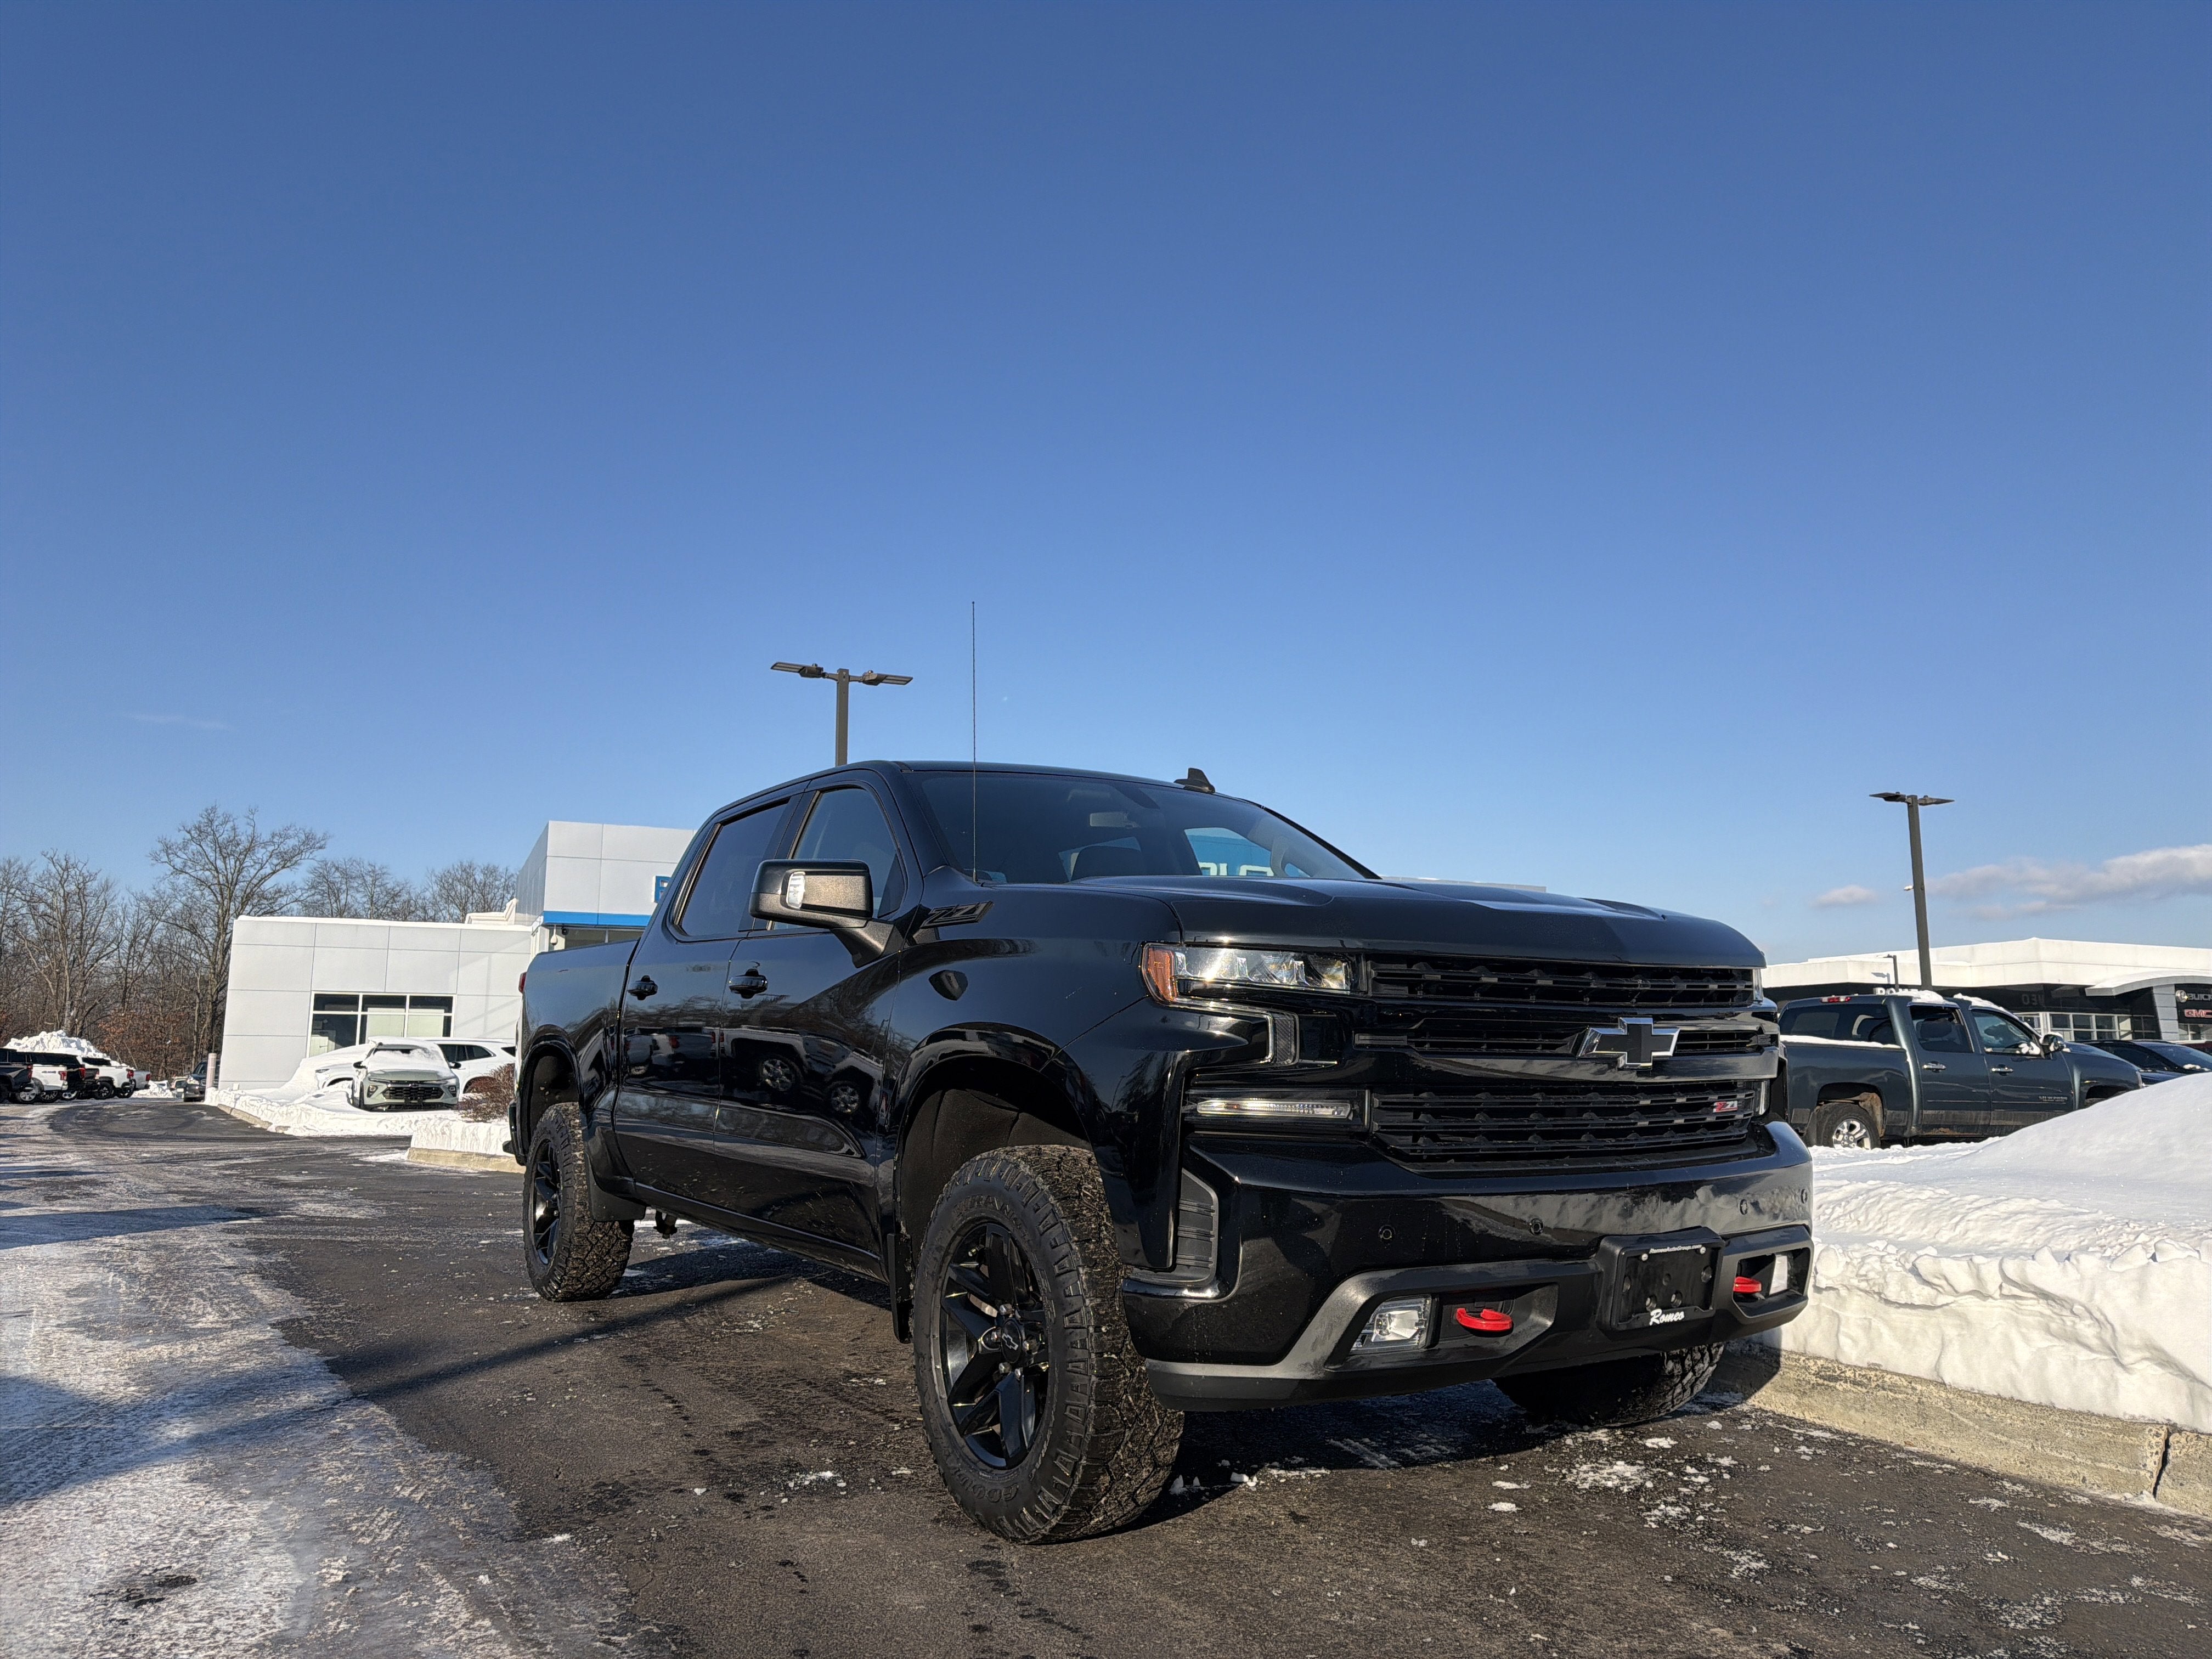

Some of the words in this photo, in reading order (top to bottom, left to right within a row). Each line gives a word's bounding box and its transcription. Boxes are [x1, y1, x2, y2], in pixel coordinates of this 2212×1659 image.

[919, 901, 993, 928] Z71
[1713, 1101, 1738, 1113] Z71
[1649, 1244, 1702, 1254] RomeoAutoGroup.com
[1649, 1308, 1685, 1326] Romeo
